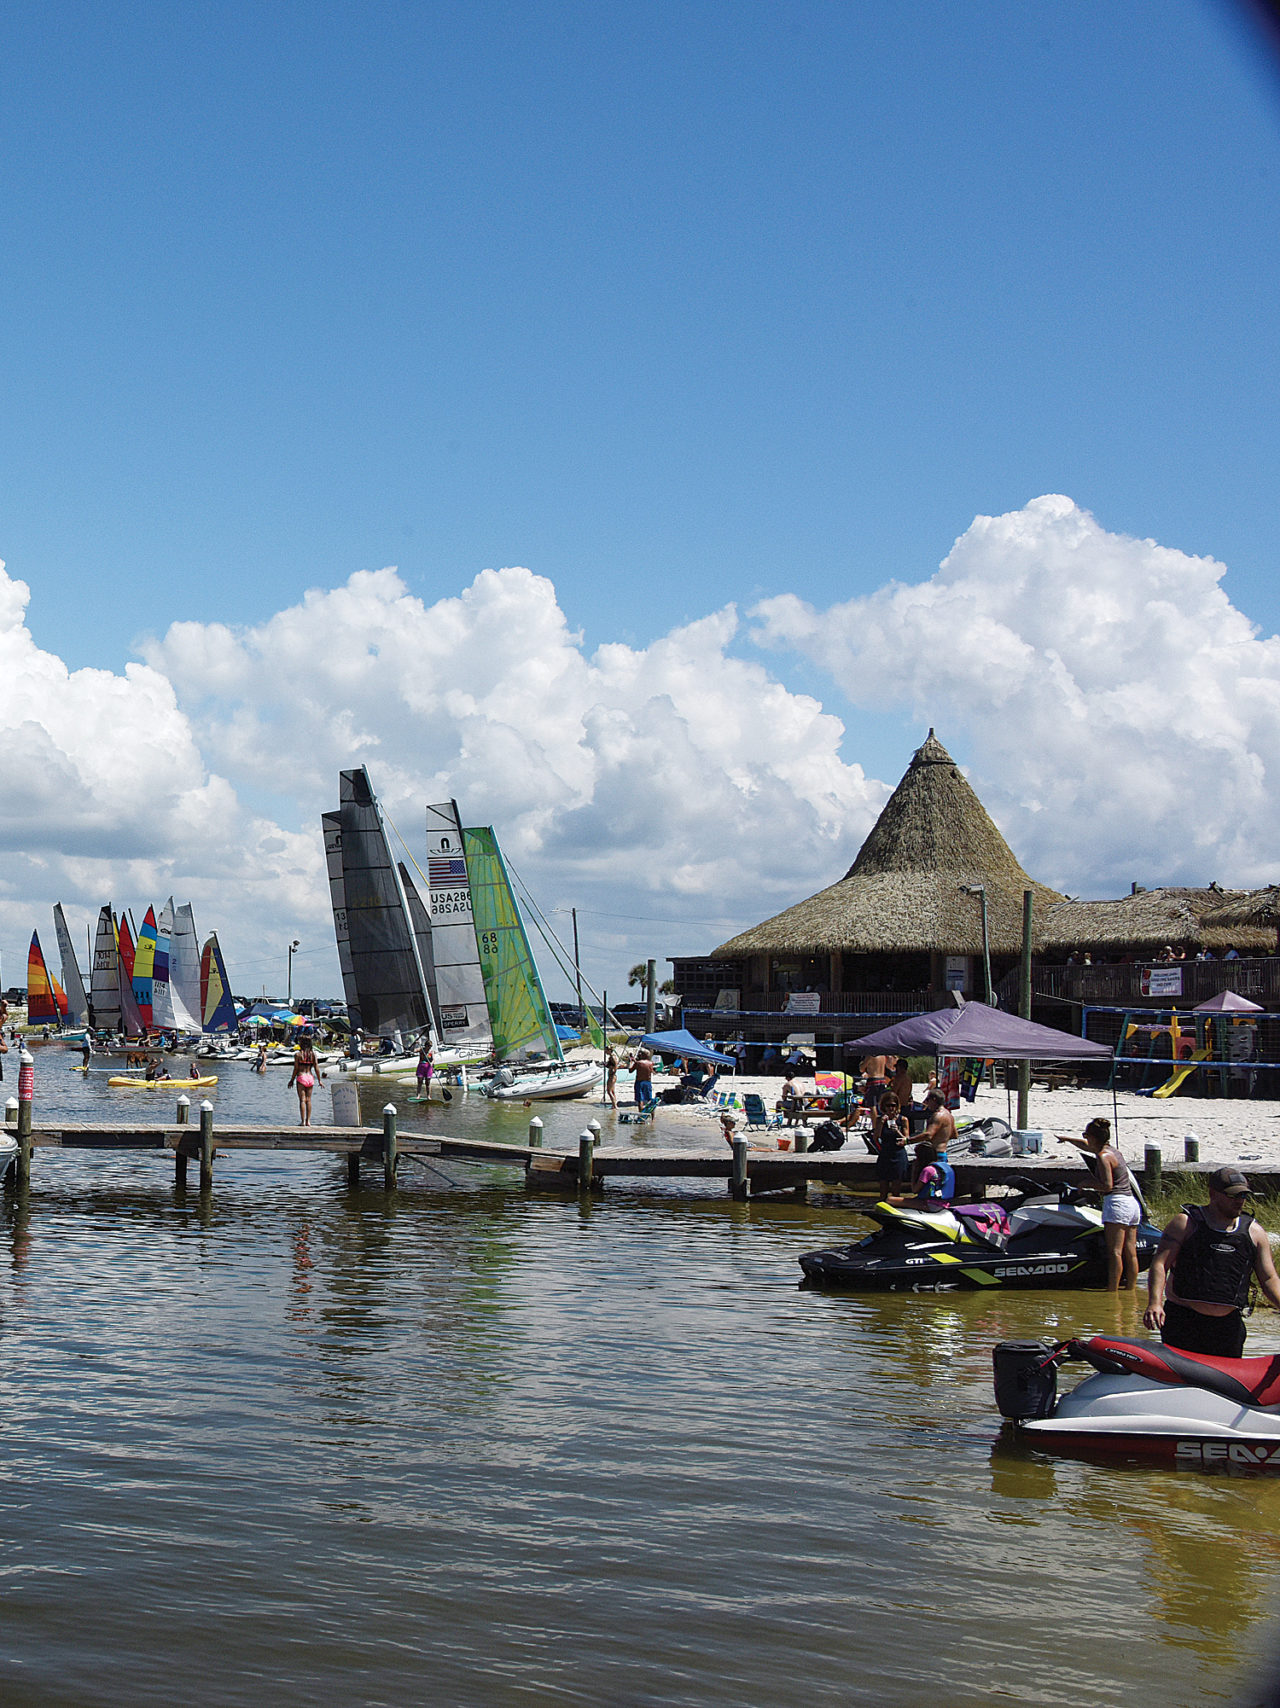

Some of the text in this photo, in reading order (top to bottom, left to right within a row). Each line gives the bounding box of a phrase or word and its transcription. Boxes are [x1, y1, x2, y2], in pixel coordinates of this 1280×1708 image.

[431, 892, 471, 903] USA286
[481, 932, 497, 943] 68
[905, 1257, 923, 1265] GTI
